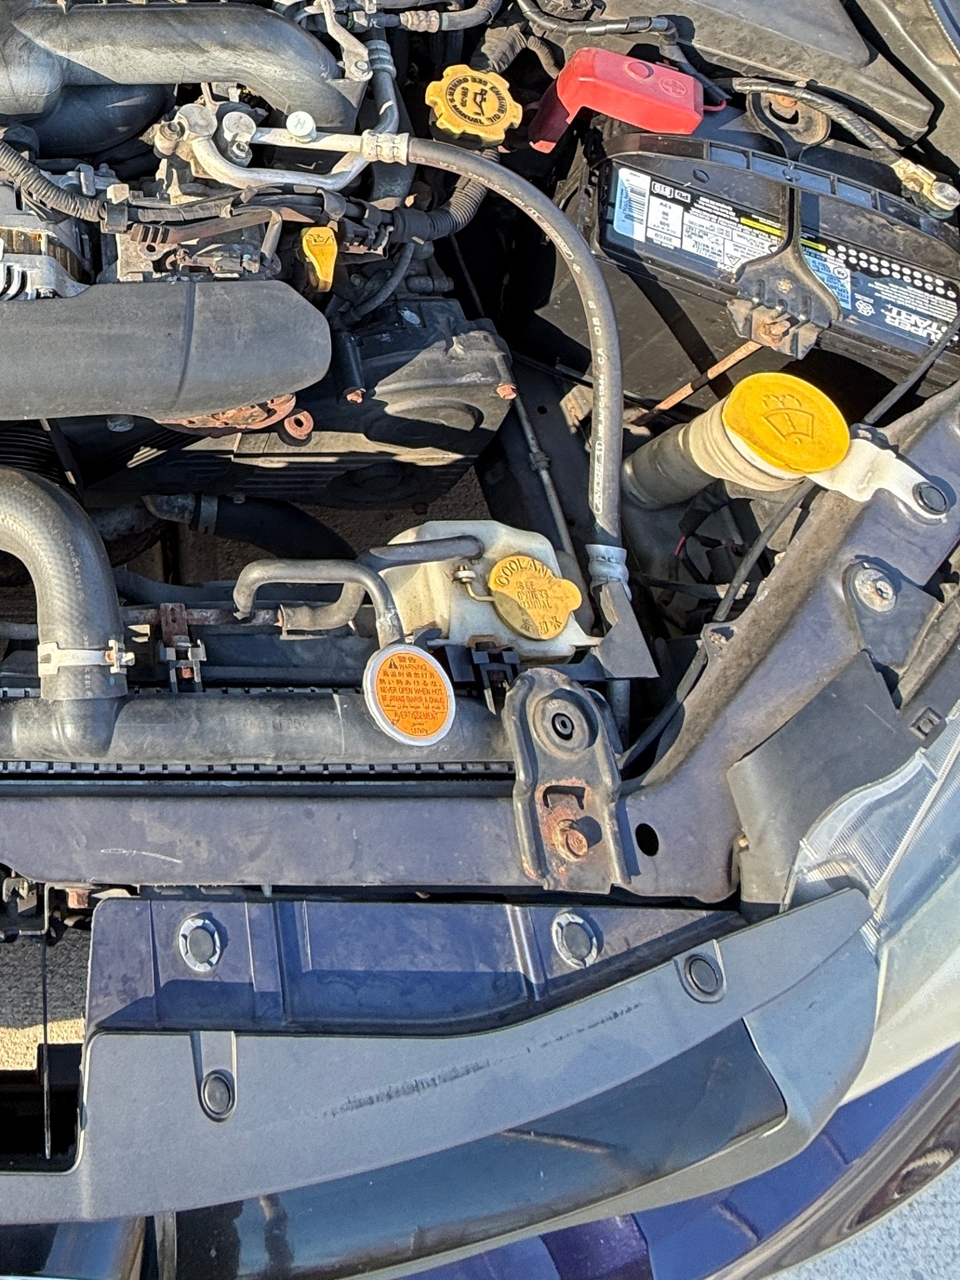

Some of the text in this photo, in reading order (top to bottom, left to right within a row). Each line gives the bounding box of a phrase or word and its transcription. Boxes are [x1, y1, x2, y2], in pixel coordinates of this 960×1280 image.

[448, 76, 488, 125] SEE OWNER'S MANUAL
[486, 86, 507, 124] ENGINE OIL
[496, 558, 555, 588] COOLANT
[516, 580, 536, 590] SEE
[399, 663, 428, 671] WARNING
[380, 686, 398, 694] NEVER
[399, 687, 413, 695] OPEN
[414, 687, 431, 696] WHEN
